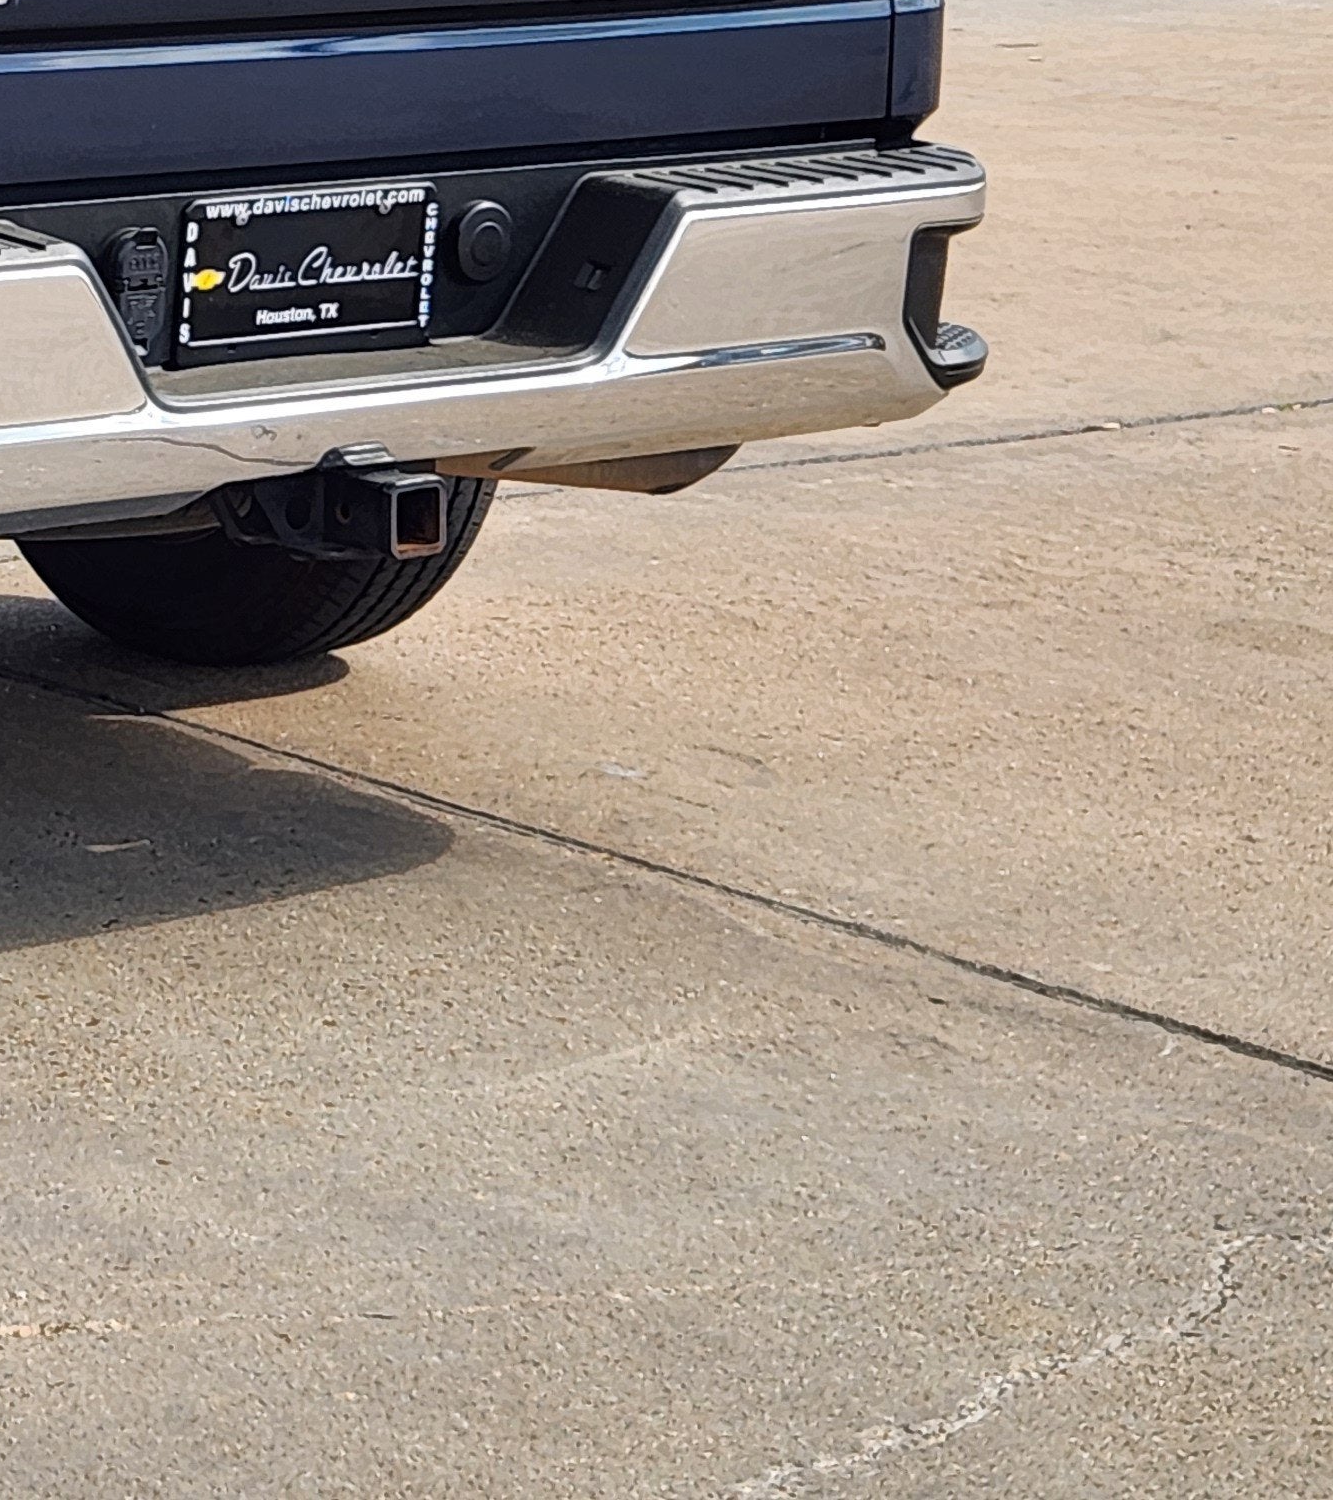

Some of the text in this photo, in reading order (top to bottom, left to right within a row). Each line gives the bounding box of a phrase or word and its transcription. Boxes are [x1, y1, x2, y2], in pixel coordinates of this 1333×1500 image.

[206, 189, 425, 219] www.davischevrolet.com
[179, 221, 199, 344] DAVIS
[228, 246, 419, 293] Davis Chevrolet
[418, 202, 438, 328] CHEVROLET
[256, 303, 339, 326] Houston, TX
